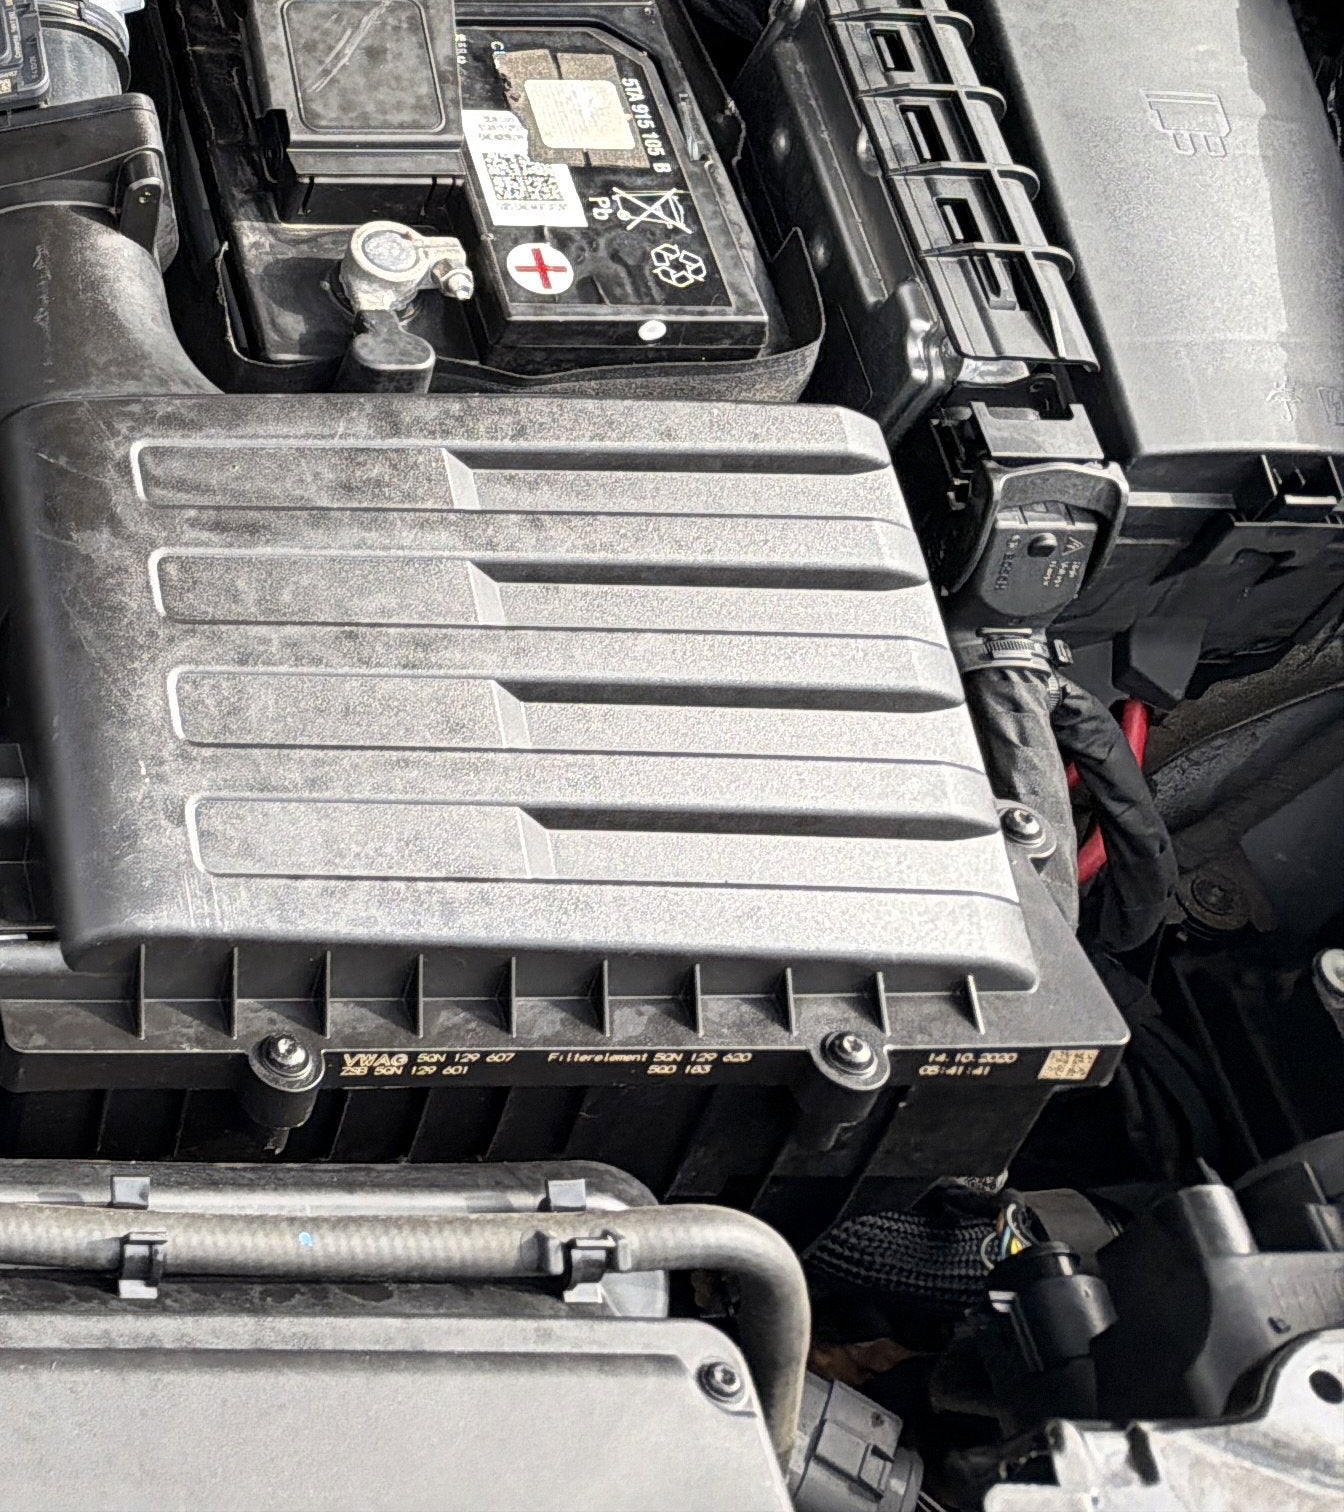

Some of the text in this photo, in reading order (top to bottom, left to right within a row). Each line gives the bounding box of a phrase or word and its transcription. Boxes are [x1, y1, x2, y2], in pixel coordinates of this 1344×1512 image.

[631, 105, 655, 129] 915
[642, 134, 666, 157] 105
[653, 163, 672, 173] B
[588, 196, 609, 221] Pb
[454, 1053, 480, 1062] 129
[486, 1053, 515, 1062] 607
[547, 1052, 648, 1063] Filterelement
[691, 1052, 718, 1062] 129
[722, 1052, 752, 1063] 620
[411, 1066, 437, 1075] 129
[442, 1066, 469, 1075] 601
